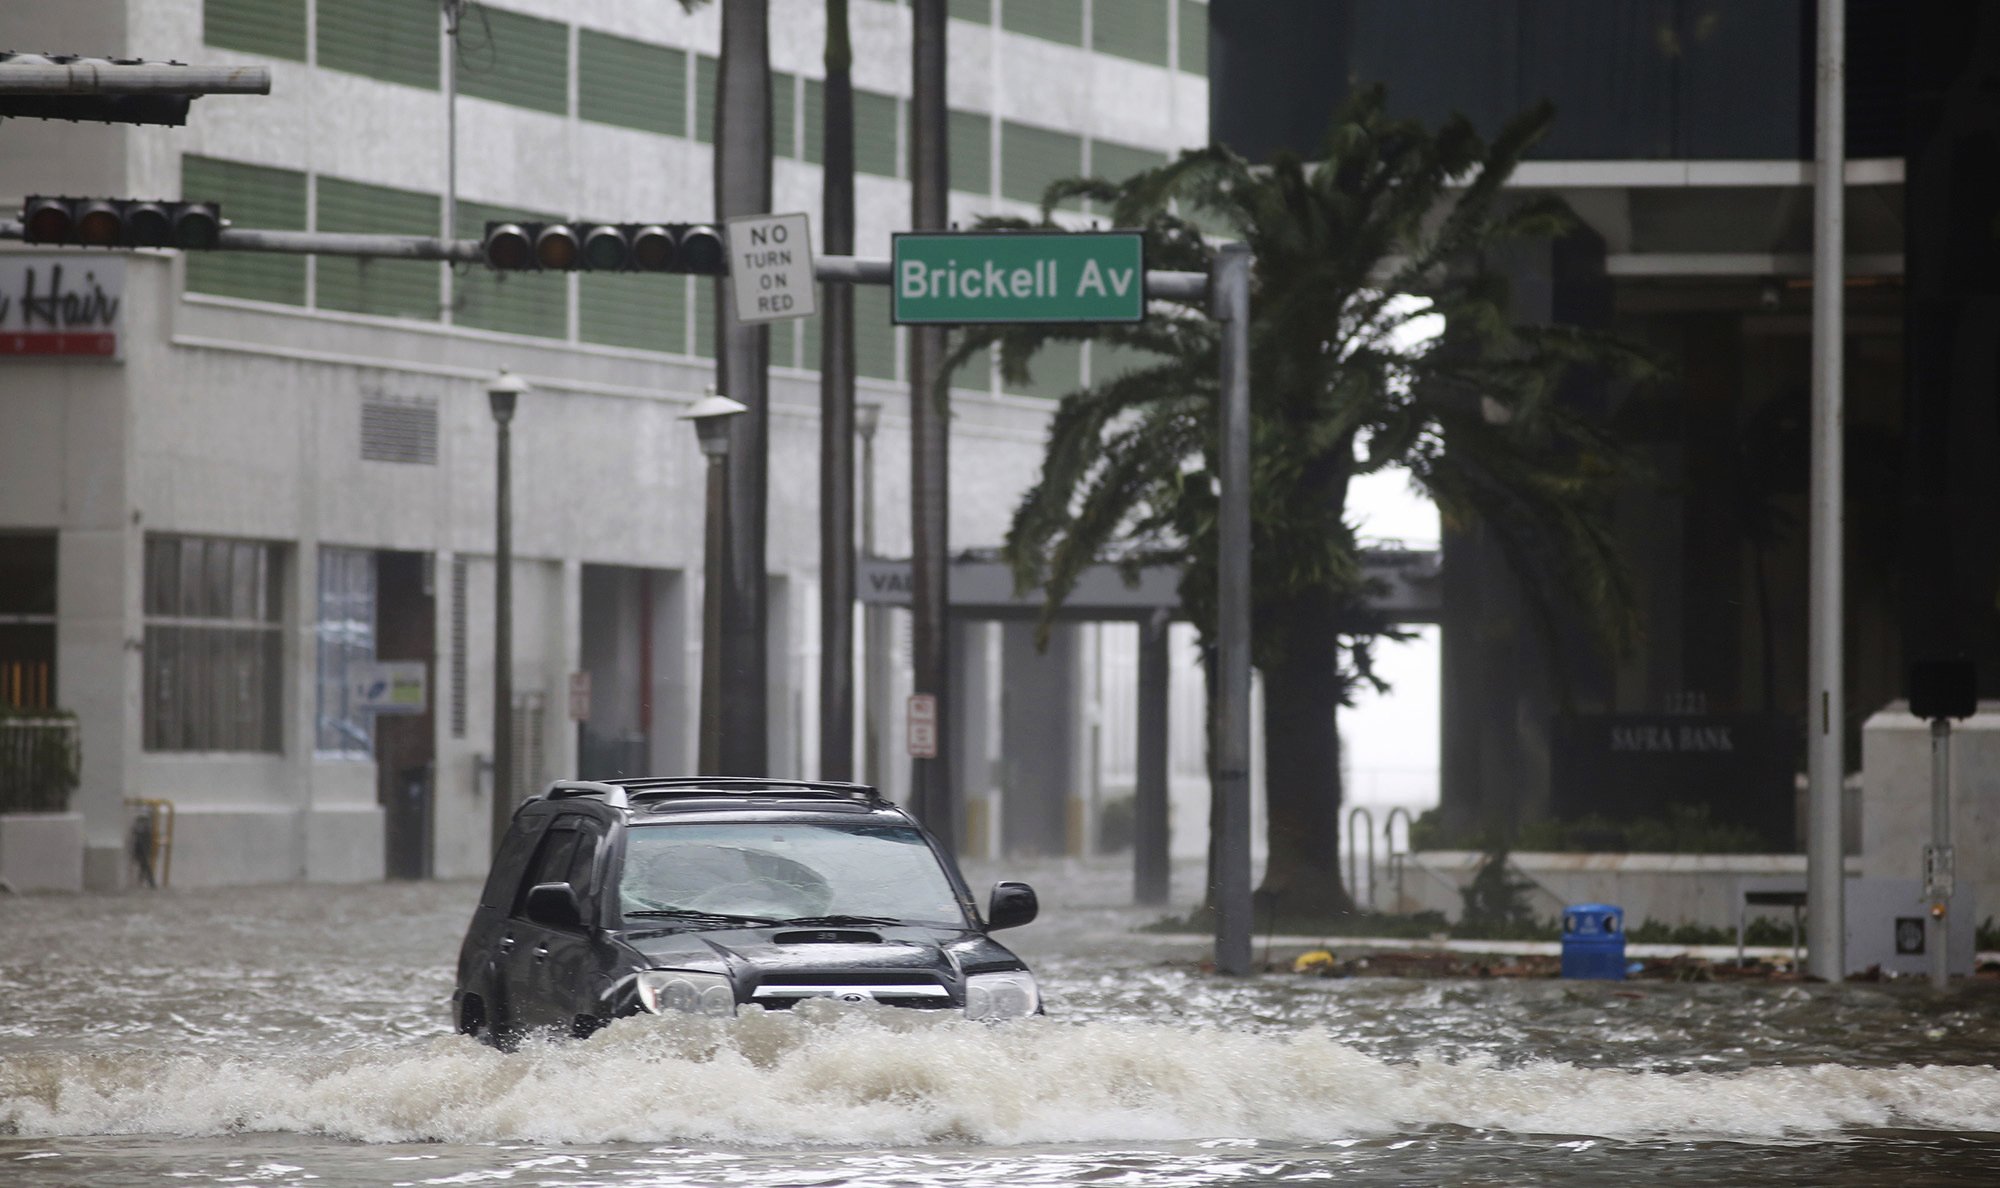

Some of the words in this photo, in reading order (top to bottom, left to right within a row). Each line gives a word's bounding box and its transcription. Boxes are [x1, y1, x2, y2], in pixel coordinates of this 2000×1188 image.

[750, 225, 788, 246] NO
[743, 249, 792, 269] TURN
[760, 273, 787, 291] ON
[901, 258, 1057, 299] Brickell
[1075, 258, 1134, 298] Av
[20, 262, 119, 327] Hair
[757, 293, 794, 312] RED
[1679, 724, 1735, 750] BANK
